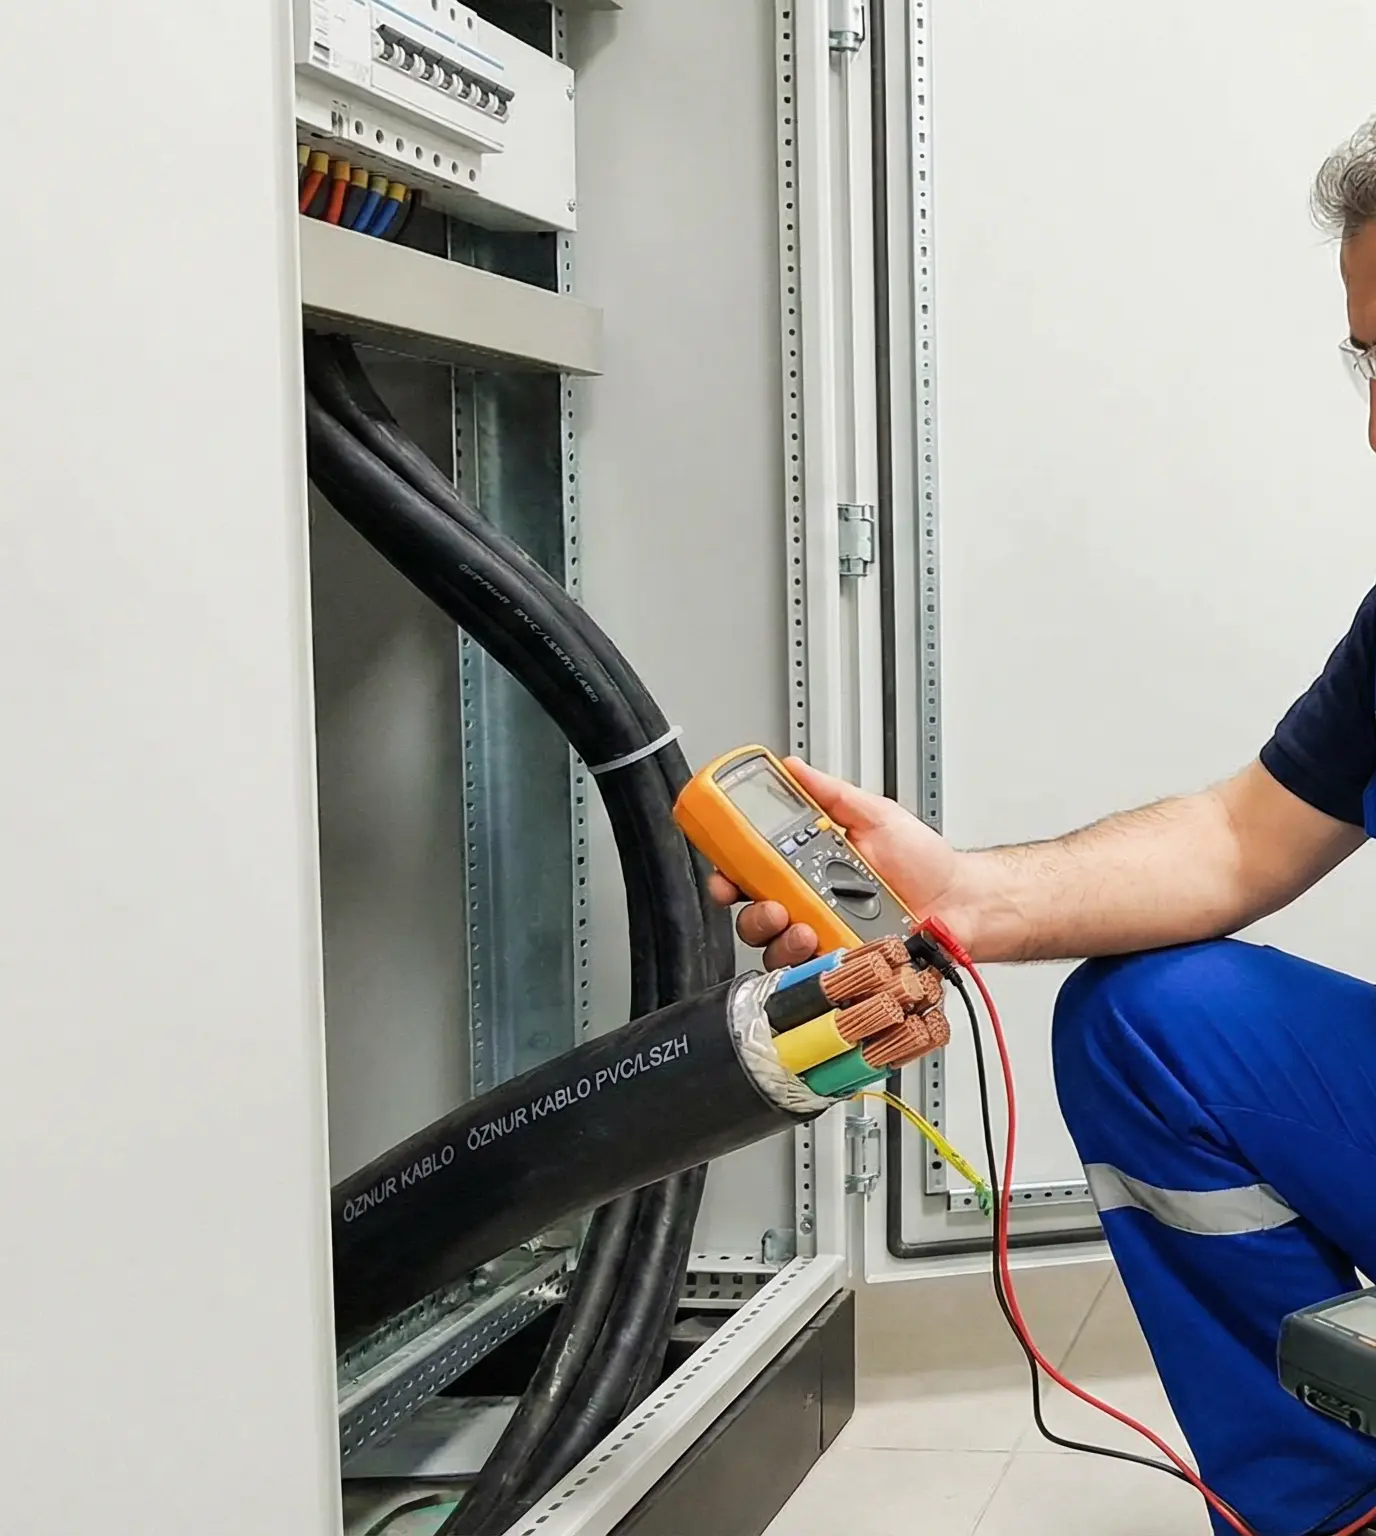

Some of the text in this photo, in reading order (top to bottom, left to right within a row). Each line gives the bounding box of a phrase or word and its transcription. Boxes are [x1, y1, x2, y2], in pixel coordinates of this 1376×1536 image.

[401, 1145, 455, 1189] KABLO
[531, 1078, 591, 1121] KABLO
[595, 1034, 689, 1091] PVC/LSZH
